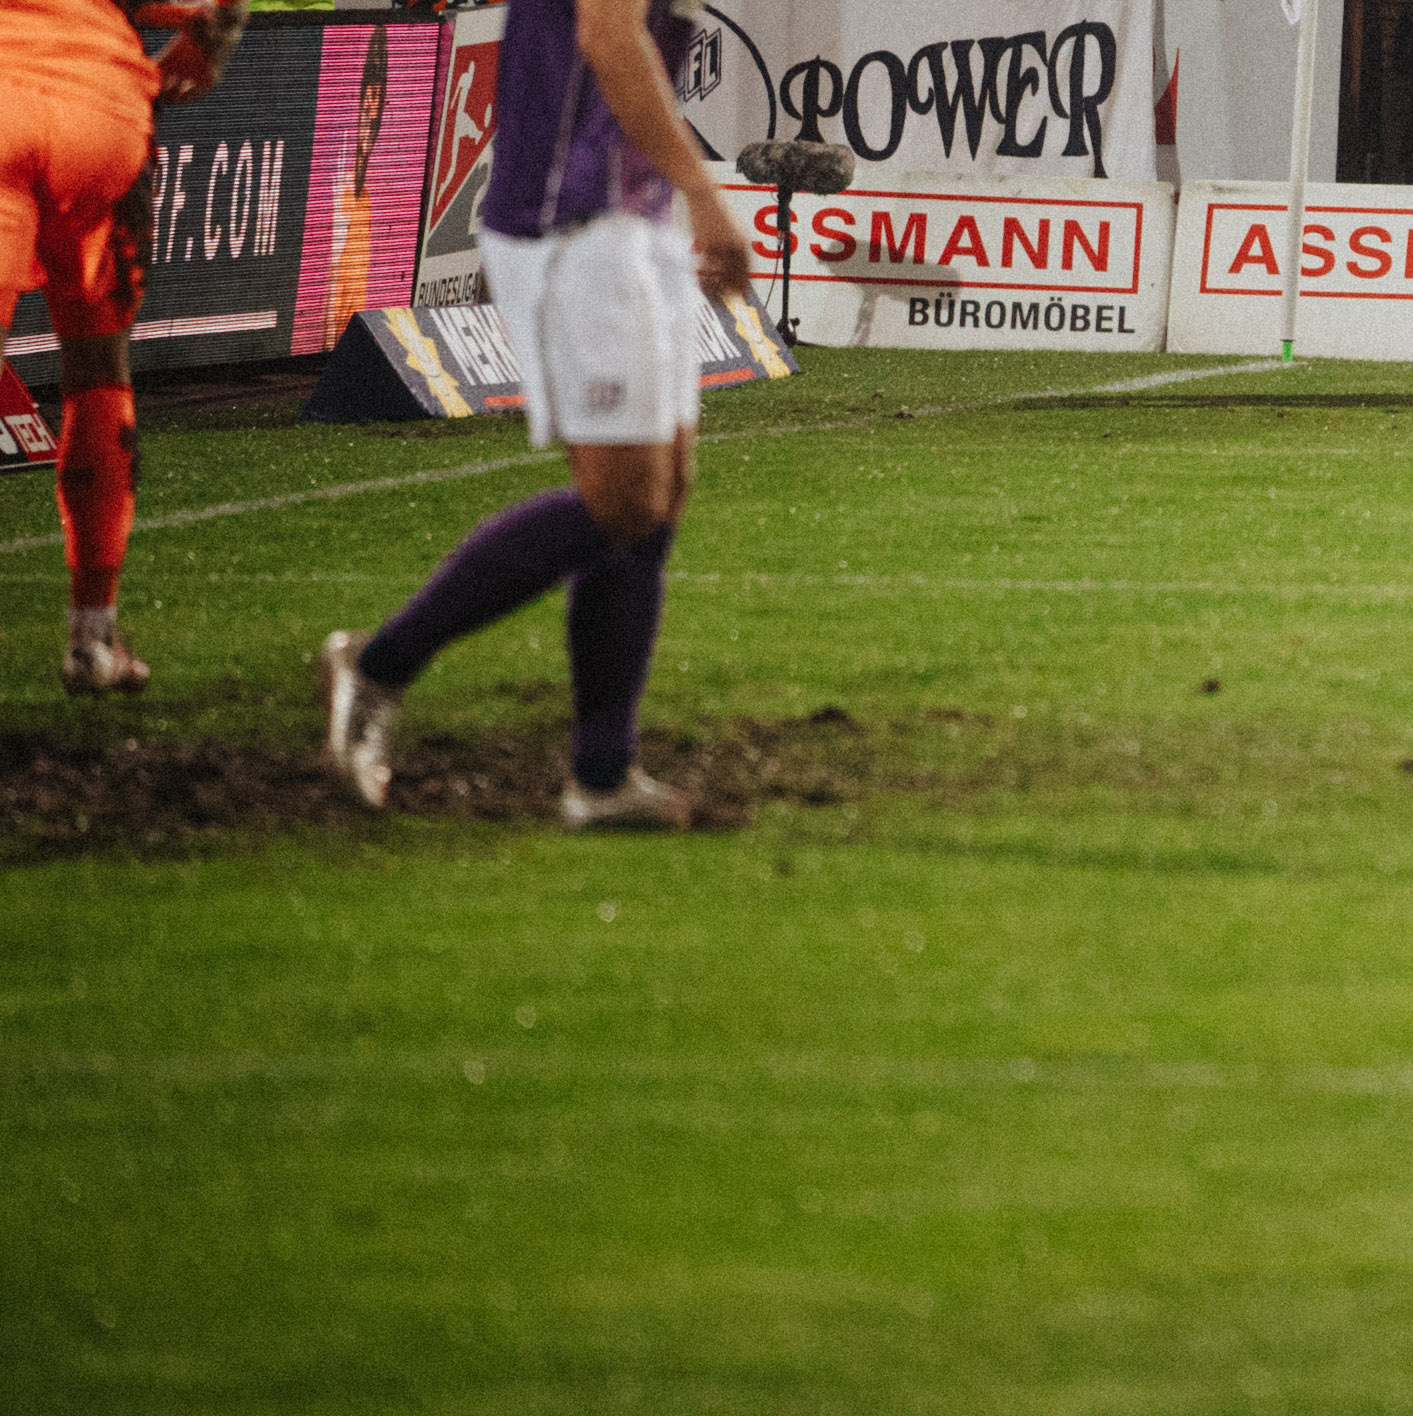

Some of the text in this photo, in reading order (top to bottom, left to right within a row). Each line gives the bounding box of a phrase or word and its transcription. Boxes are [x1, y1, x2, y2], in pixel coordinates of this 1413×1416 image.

[780, 19, 1117, 180] POWER
[752, 205, 1111, 272] SSMANN
[907, 297, 1136, 335] BÜROMÖBEL
